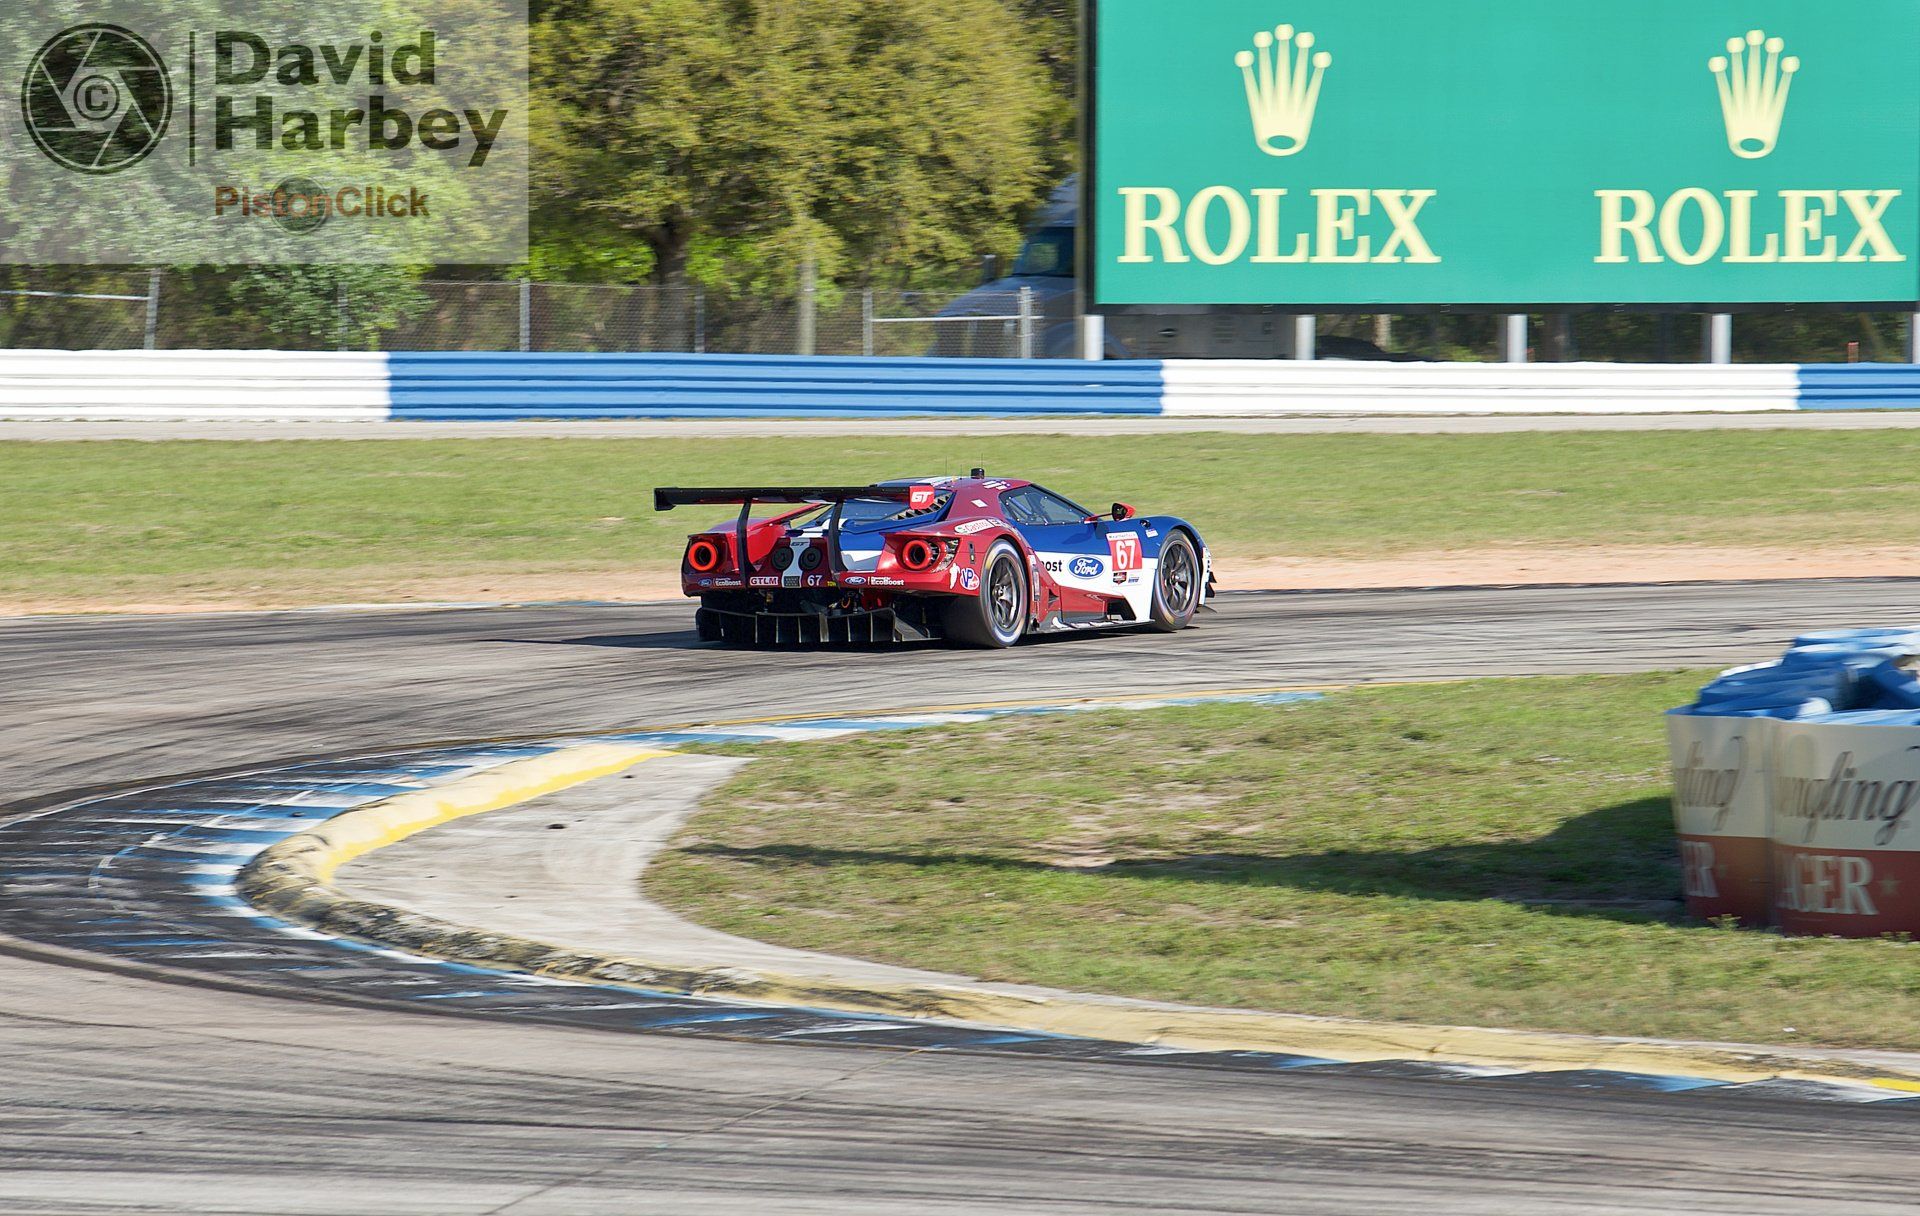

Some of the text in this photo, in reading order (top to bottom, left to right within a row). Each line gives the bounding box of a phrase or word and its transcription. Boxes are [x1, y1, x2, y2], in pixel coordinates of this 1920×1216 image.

[1117, 185, 1442, 266] ROLEX
[1594, 186, 1907, 266] ROLEX
[911, 491, 934, 503] GT
[1115, 539, 1136, 570] 67
[1074, 557, 1099, 576] Ford
[750, 577, 778, 585] GTLM
[807, 574, 823, 586] 67
[962, 568, 974, 588] VP
